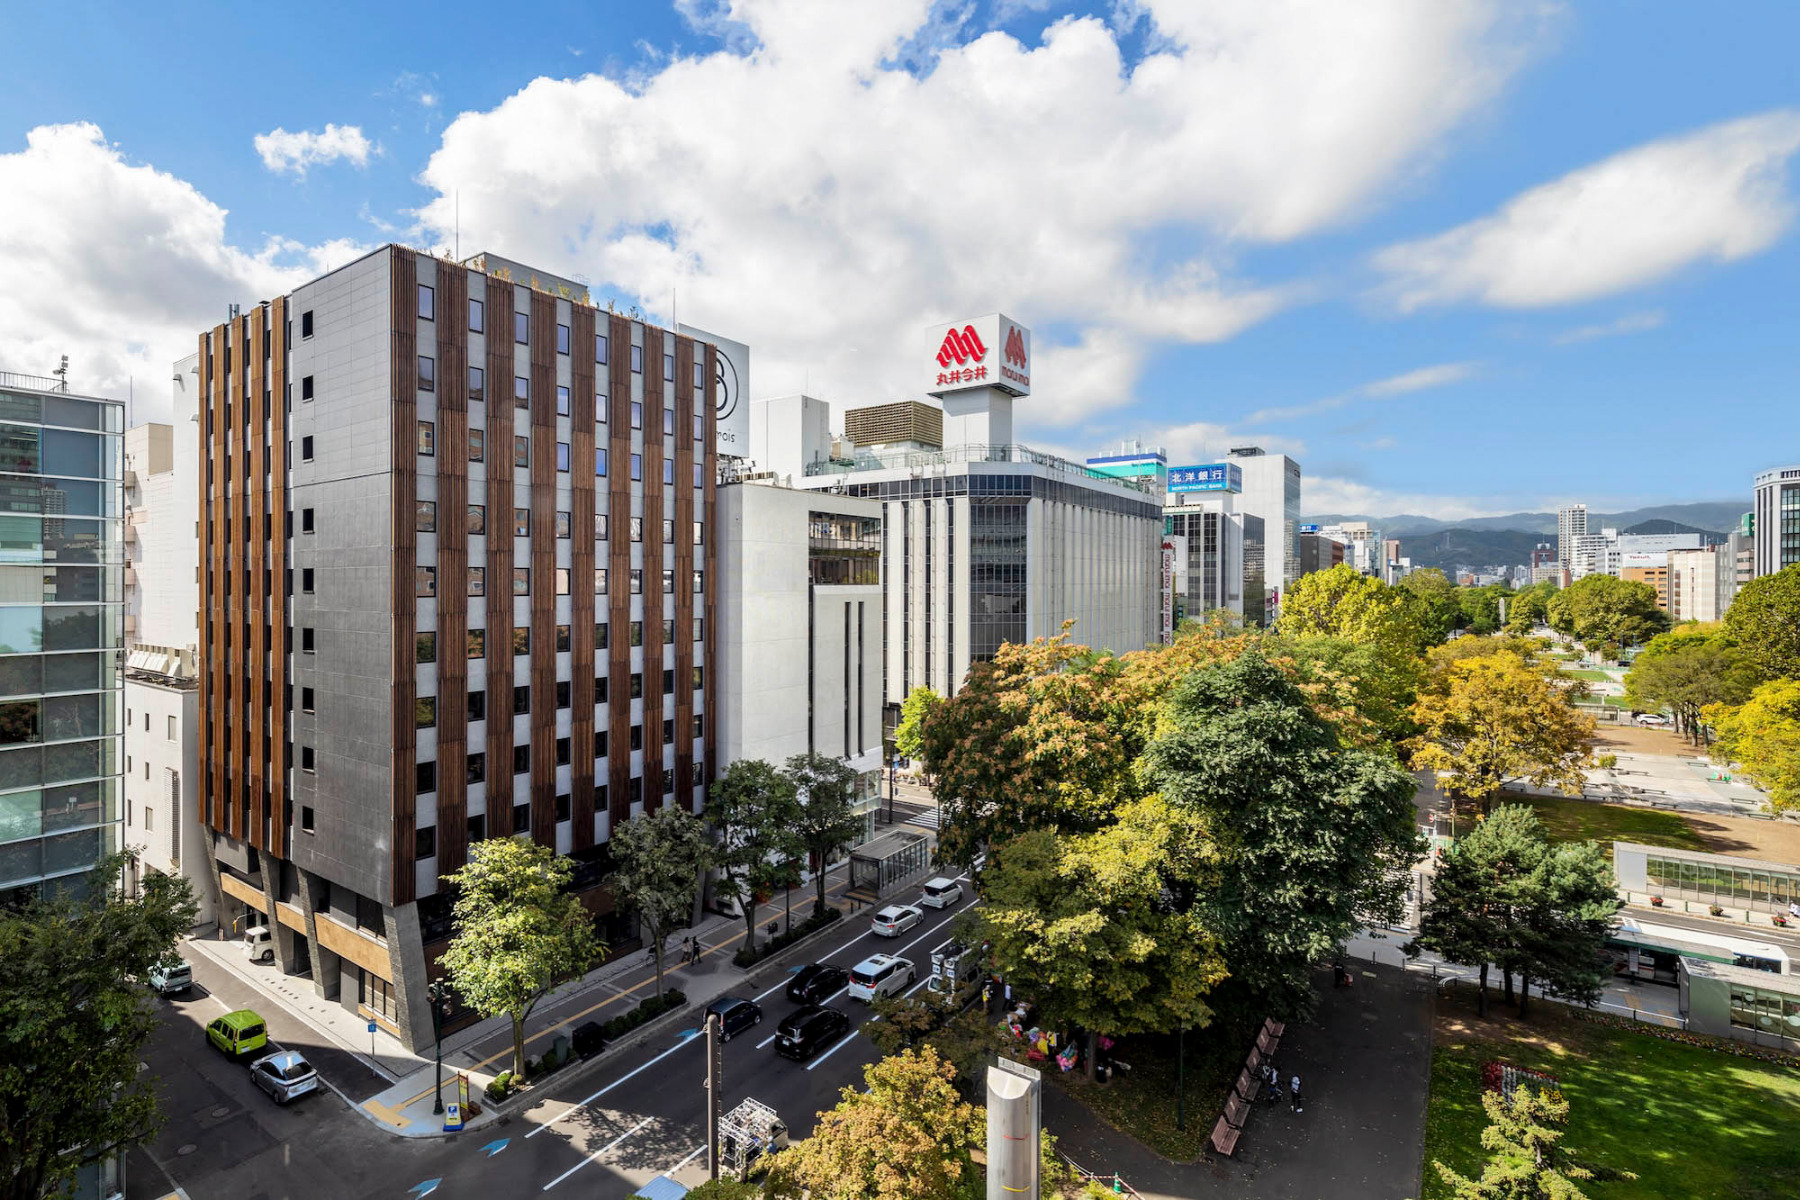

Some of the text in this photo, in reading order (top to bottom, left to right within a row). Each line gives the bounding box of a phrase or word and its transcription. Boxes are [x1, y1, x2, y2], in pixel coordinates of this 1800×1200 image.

[936, 365, 987, 386] 丸井今井
[1172, 469, 1223, 483] 北洋銀行
